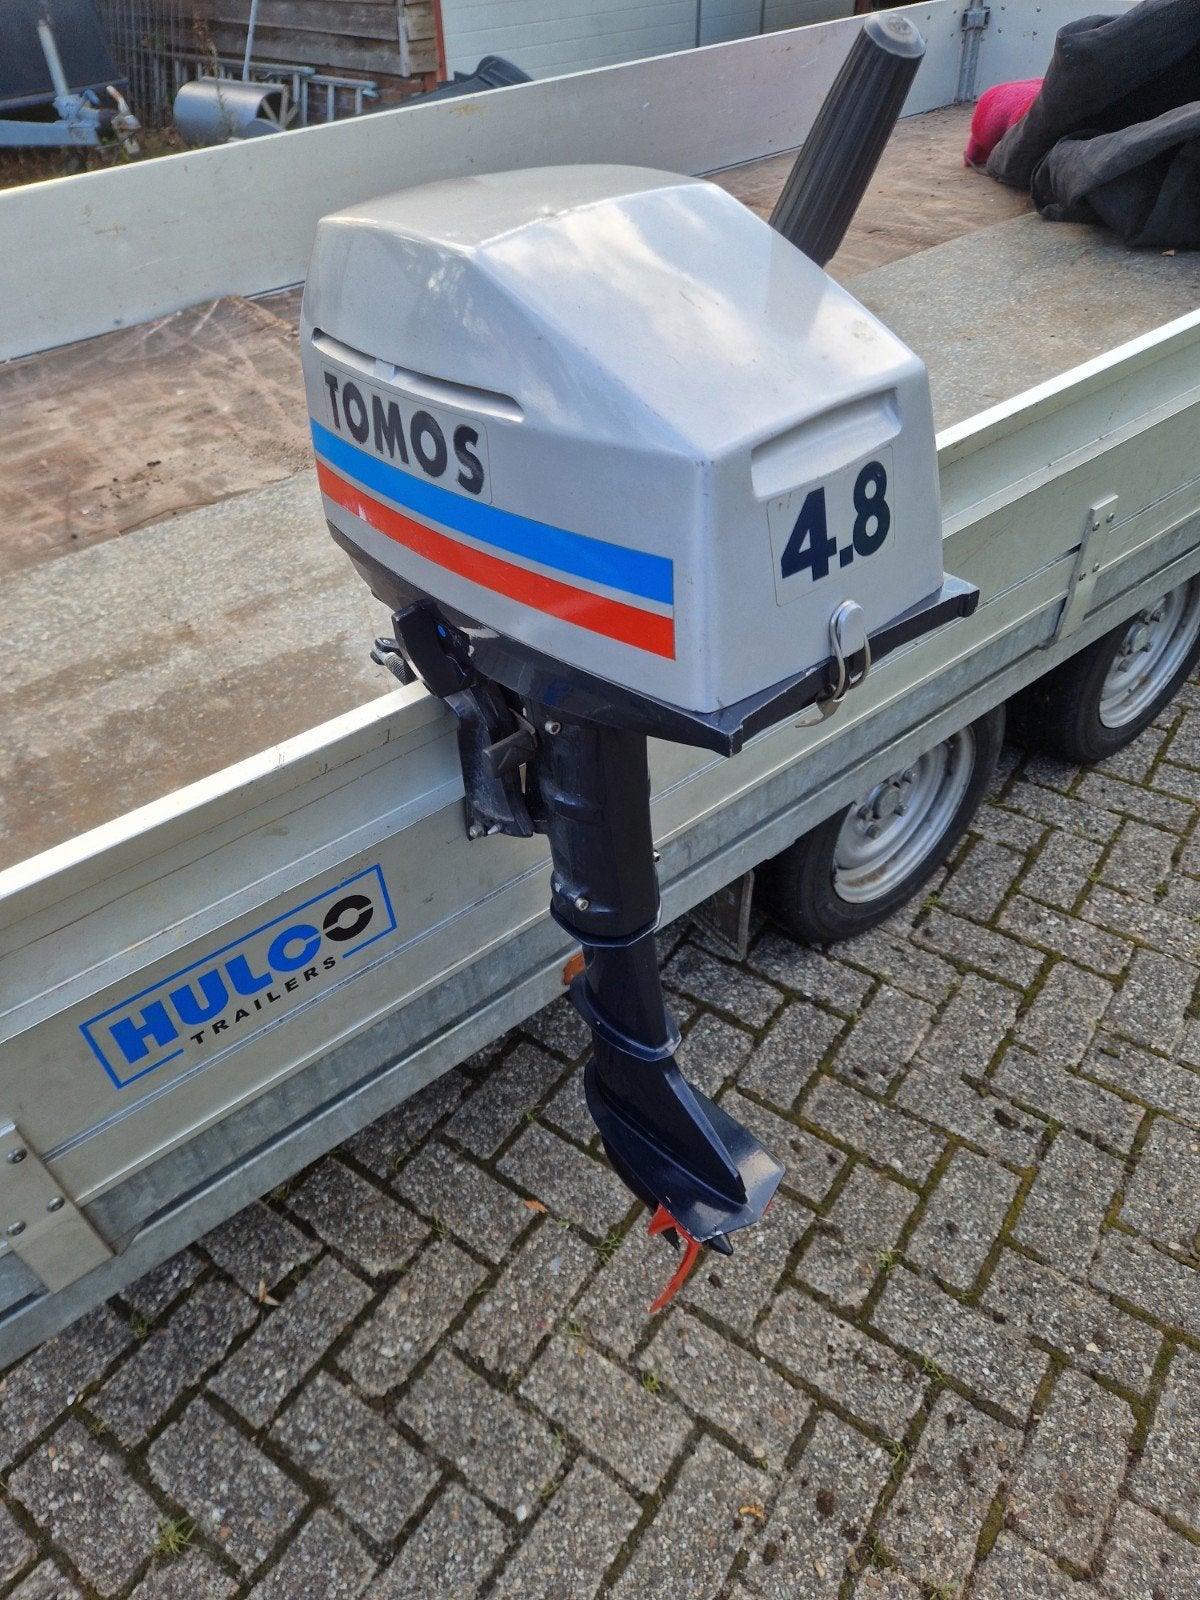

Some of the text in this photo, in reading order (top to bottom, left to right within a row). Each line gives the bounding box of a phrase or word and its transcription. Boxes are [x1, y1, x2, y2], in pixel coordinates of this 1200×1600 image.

[324, 371, 485, 495] TOMOS
[780, 460, 891, 582] 4.8
[108, 894, 374, 1064] HULCO
[190, 956, 336, 1045] TRAILERS
